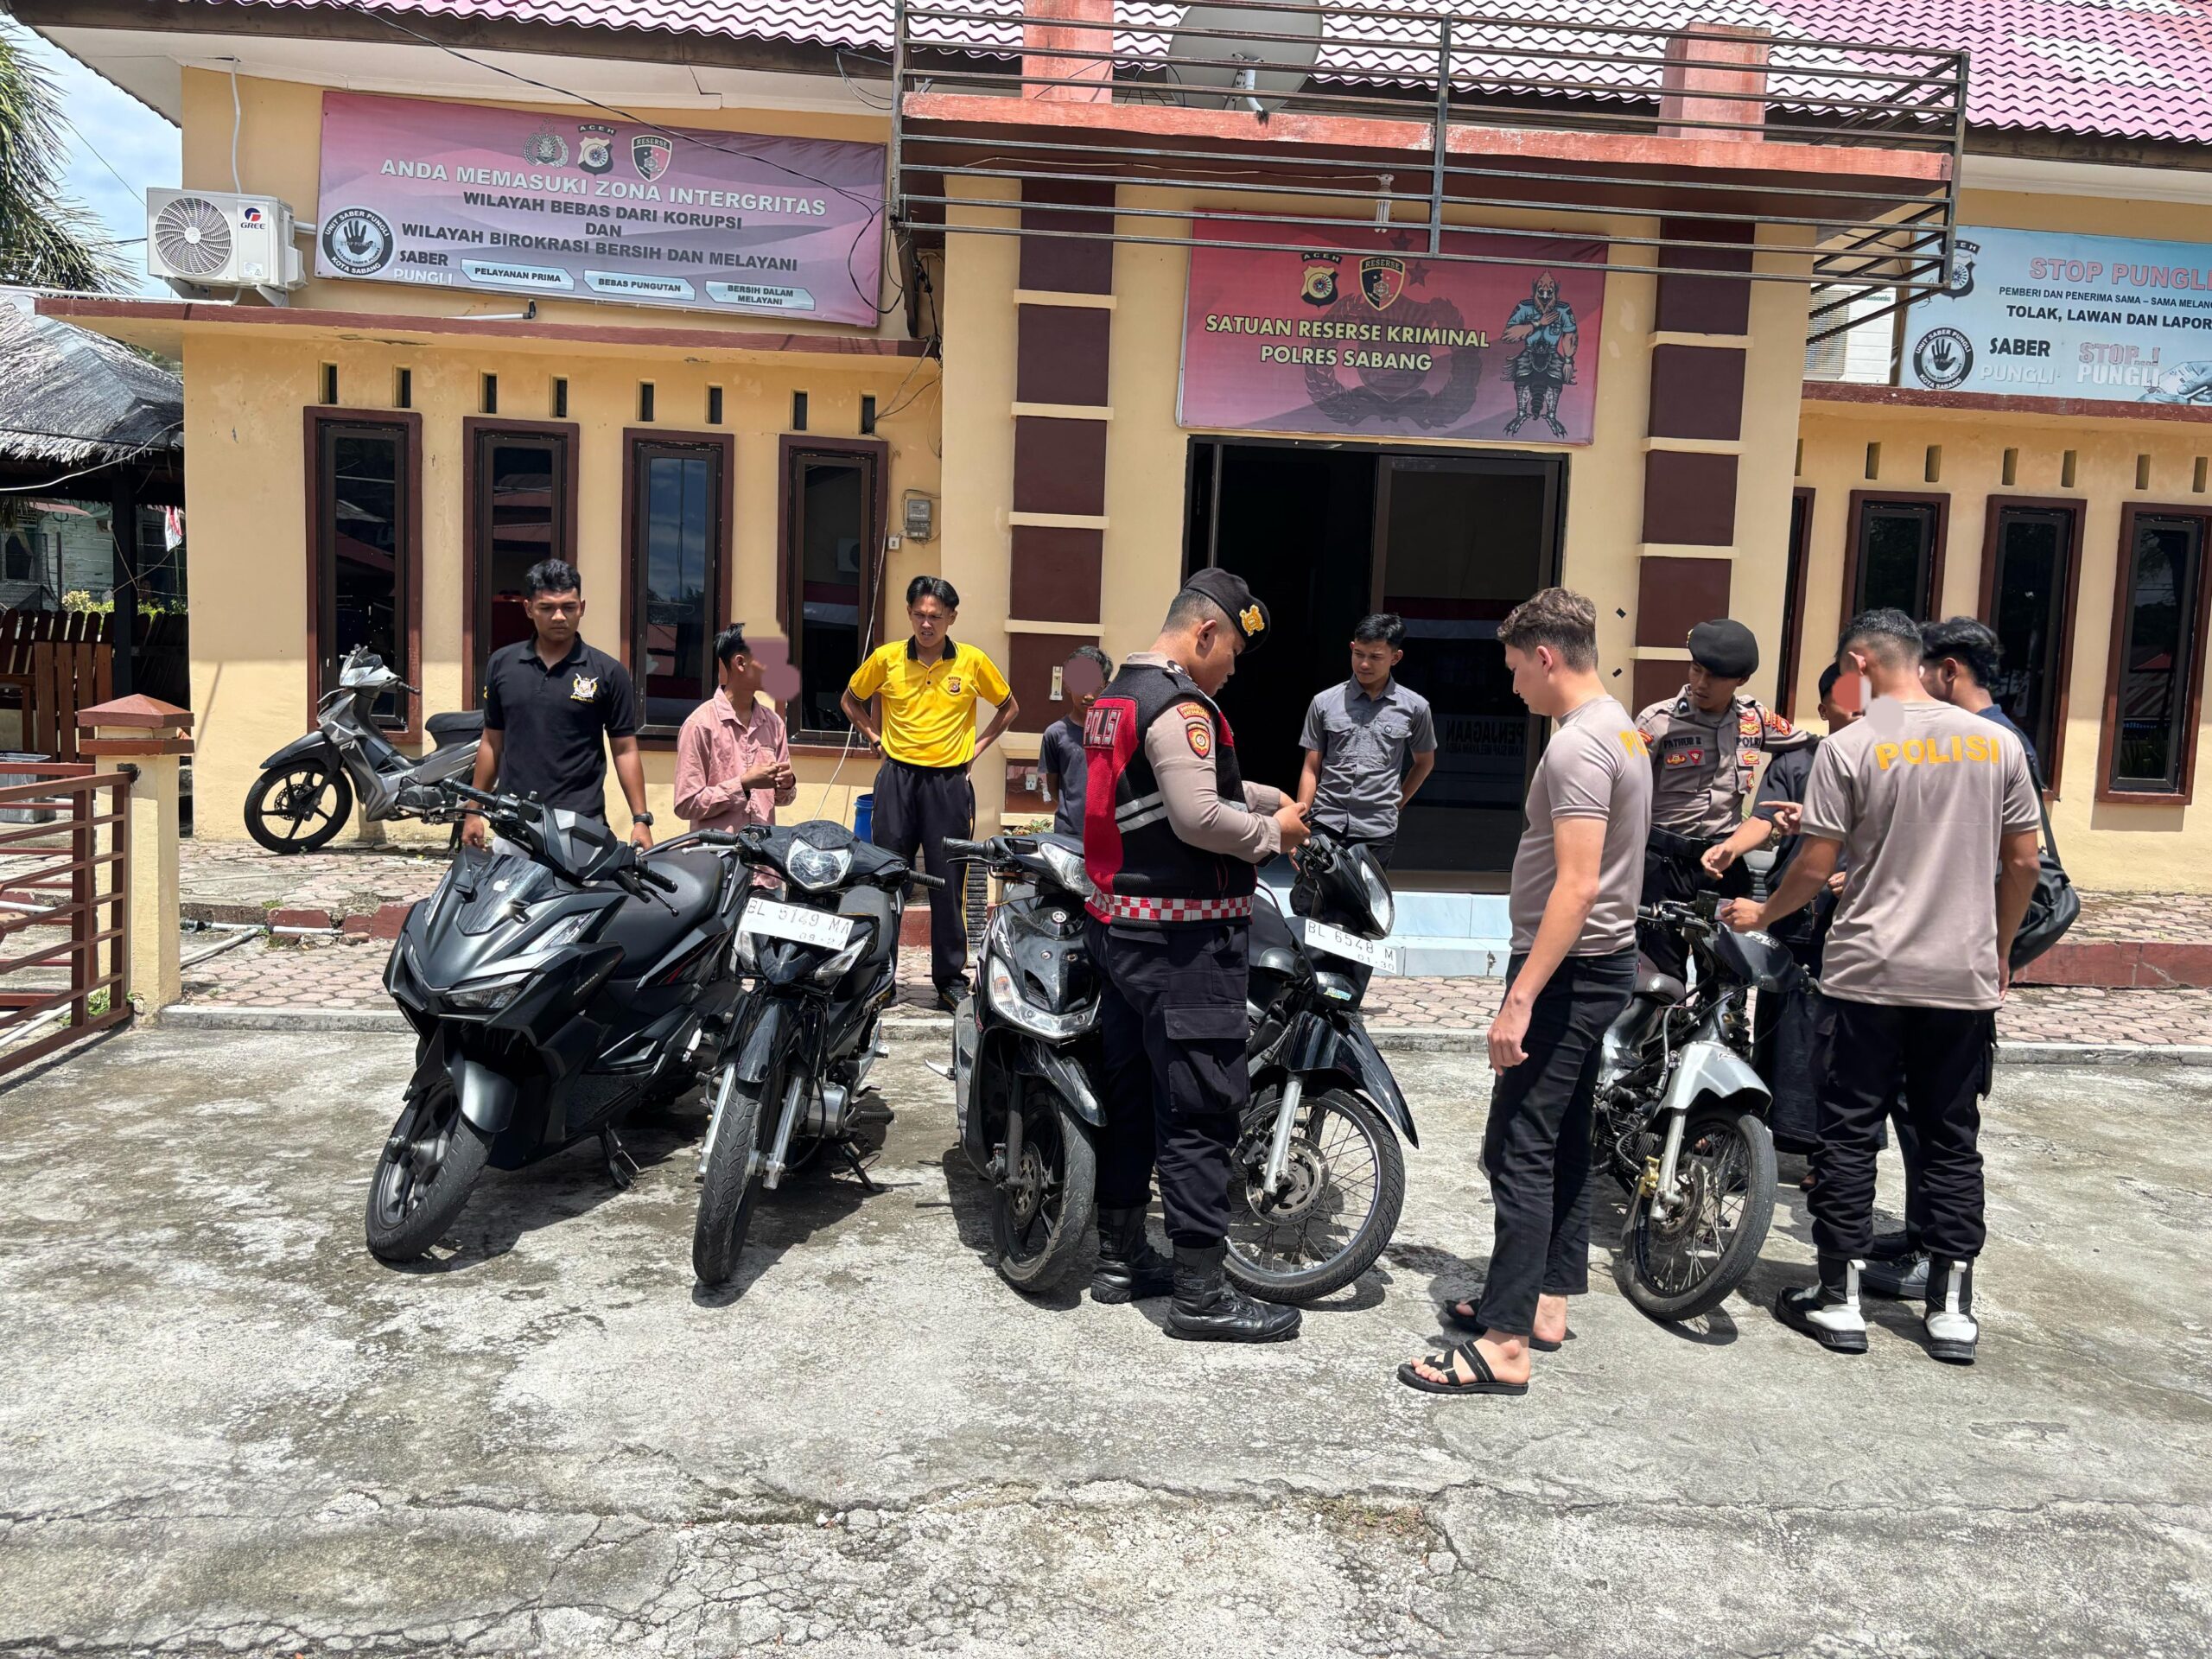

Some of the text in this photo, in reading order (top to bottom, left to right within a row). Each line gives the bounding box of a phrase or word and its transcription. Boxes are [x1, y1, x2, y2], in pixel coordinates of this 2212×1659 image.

[580, 124, 615, 135] ACEH
[636, 137, 668, 149] RESERSE
[380, 159, 826, 216] ANDA MEMASUKI ZONA INTERGRITAS
[463, 192, 742, 230] WILAYAH BEBAS DARI KORUPSI
[324, 210, 390, 237] UNIT SABER PUNGLI
[585, 222, 621, 237] DAN
[402, 223, 798, 271] WILAYAH BIROKRASI BERSIH DAN MELAYANI
[331, 256, 381, 275] KOTA SABANG
[399, 250, 448, 266] SABER
[1303, 252, 1340, 263] ACEH
[1365, 259, 1400, 270] RESERSE
[393, 268, 454, 284] PUNGLI
[474, 267, 562, 283] PELAYANAN PRIMA
[2029, 257, 2212, 291] STOP PUNGLI
[598, 278, 681, 292] BEBAS PUNGUTAN
[728, 284, 793, 297] BERSIH DALAM
[737, 295, 783, 305] MELAYANI
[1999, 286, 2041, 297] PEMBERI
[2044, 289, 2063, 299] DAN
[2065, 290, 2113, 302] PENERIMA
[2115, 295, 2140, 304] SAMA
[2151, 297, 2177, 307] SAMA
[2006, 305, 2212, 329] TOLAK, LAWAN DAN LAPOR
[1205, 314, 1490, 348] SATUAN RESERSE KRIMINAL
[1915, 329, 1971, 354] UNIT SABER PUNGLI
[1989, 337, 2050, 358] SABER
[1260, 344, 1433, 372] POLRES SABANG
[1919, 373, 1935, 388] KOTA
[1980, 364, 2055, 384] PUNGLI
[2076, 363, 2160, 388] PUNGLI
[1084, 709, 1122, 745] POLISI
[1736, 737, 1761, 747] POLRI
[1874, 735, 1999, 770] POLISI
[747, 899, 765, 916] BL
[1308, 921, 1393, 961] BL 6548 M
[573, 973, 599, 995] HONDA
